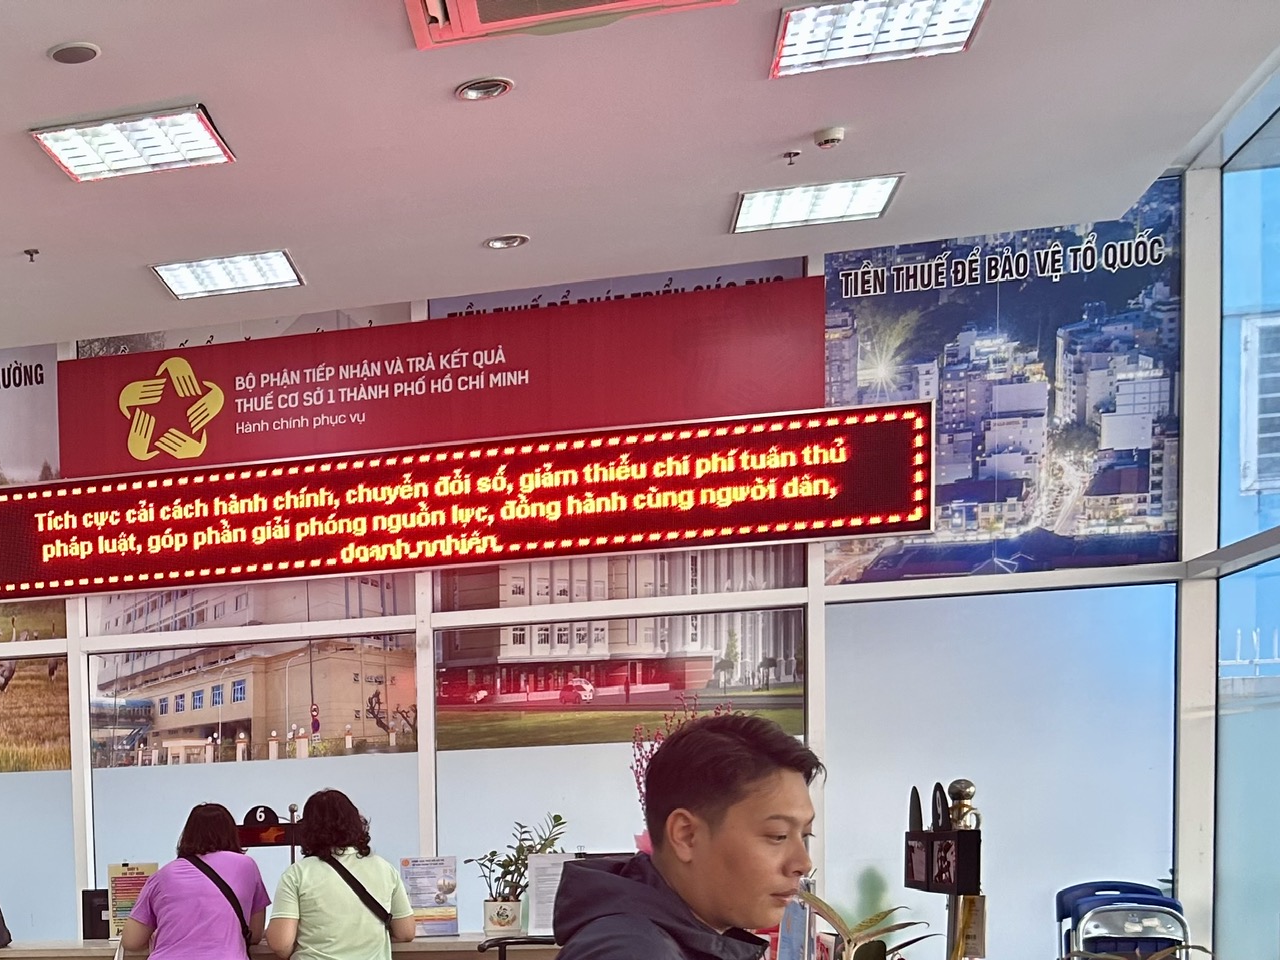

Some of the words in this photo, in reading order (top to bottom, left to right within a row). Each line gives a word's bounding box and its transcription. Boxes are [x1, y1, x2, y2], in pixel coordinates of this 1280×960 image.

[841, 260, 886, 298] TIỀN
[893, 251, 951, 292] THUẾ
[952, 247, 981, 287] ĐỂ
[986, 246, 1028, 283] BẢO
[1034, 241, 1063, 283] VỆ
[1069, 233, 1097, 274] TỔ
[1104, 228, 1165, 275] QUỐC
[235, 371, 256, 393] BỘ
[260, 367, 300, 390] PHẬN
[303, 359, 335, 384] TIẾP
[339, 359, 381, 382] NHẬN
[384, 354, 404, 375] VÀ
[406, 352, 436, 374] TRẢ
[439, 345, 469, 370] KẾT
[472, 344, 506, 368] QUẢ
[235, 391, 274, 413] THUẾ
[277, 392, 299, 409] CƠ
[303, 387, 324, 407] SỞ
[327, 388, 335, 404] 1
[338, 383, 389, 403] THÀNH
[394, 376, 426, 398] PHỐ
[430, 371, 454, 394] HỒ
[457, 370, 485, 391] CHÍ
[489, 369, 530, 389] MINH
[236, 419, 269, 434] Hành
[272, 414, 309, 431] chính
[312, 411, 346, 428] phục
[349, 412, 366, 426] vụ
[34, 509, 77, 532] Tích
[82, 509, 120, 530] cực
[125, 499, 155, 523] cải
[159, 498, 209, 521] cách
[213, 492, 268, 516] hành
[273, 486, 340, 511] chính,
[345, 472, 429, 505] chuyển
[434, 468, 471, 497] đổi
[476, 464, 515, 496] số,
[519, 462, 579, 494] giảm
[694, 446, 738, 479] phí
[802, 436, 847, 465] thủ
[42, 535, 93, 562] pháp
[97, 531, 142, 556] luật,
[147, 527, 188, 554] góp
[193, 519, 247, 550] phần
[252, 515, 290, 545] giải
[296, 512, 367, 542] phóng
[372, 500, 446, 535] nguồn
[452, 503, 496, 529] lực,
[500, 493, 561, 521] đồng
[566, 491, 628, 516] hành
[633, 485, 695, 511] cùng
[700, 477, 777, 508] người
[782, 472, 840, 500] dân,
[255, 807, 266, 822] 6
[935, 790, 943, 827] 9
